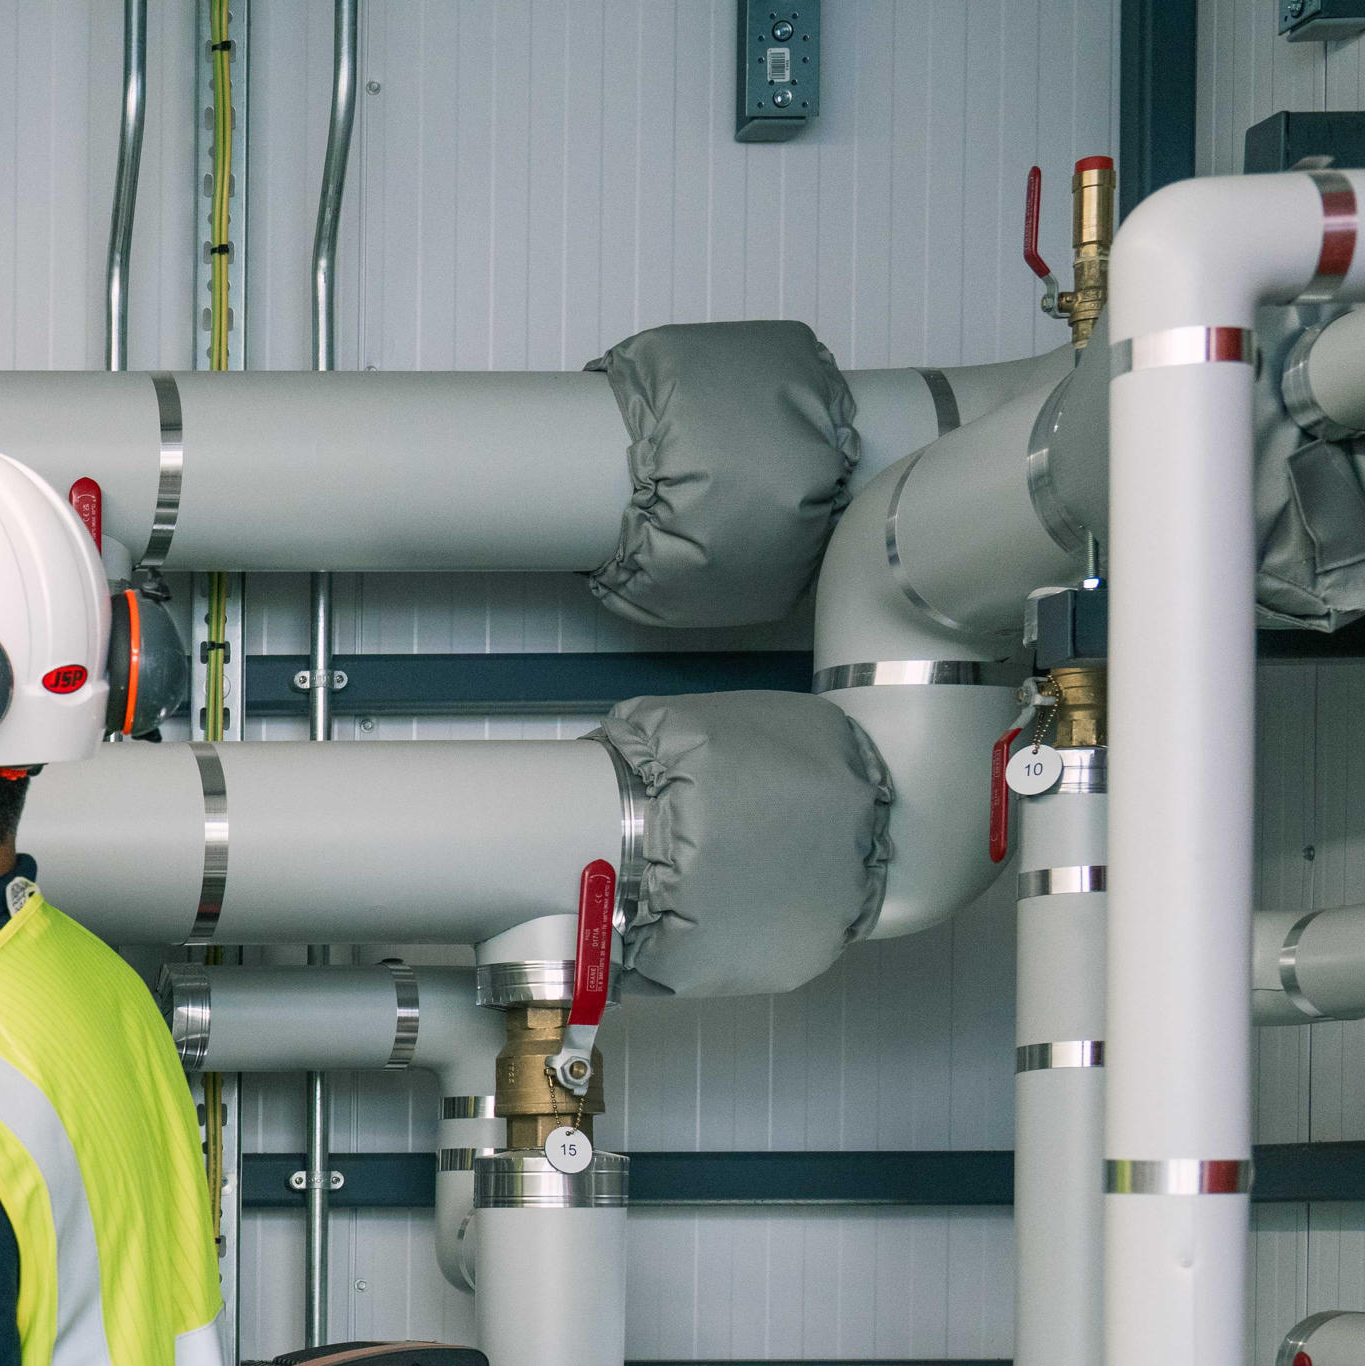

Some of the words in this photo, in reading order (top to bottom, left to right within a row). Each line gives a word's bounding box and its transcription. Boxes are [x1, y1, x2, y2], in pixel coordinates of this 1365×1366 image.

[49, 669, 84, 688] JSP
[1024, 762, 1044, 776] 10
[560, 1143, 577, 1157] 15
